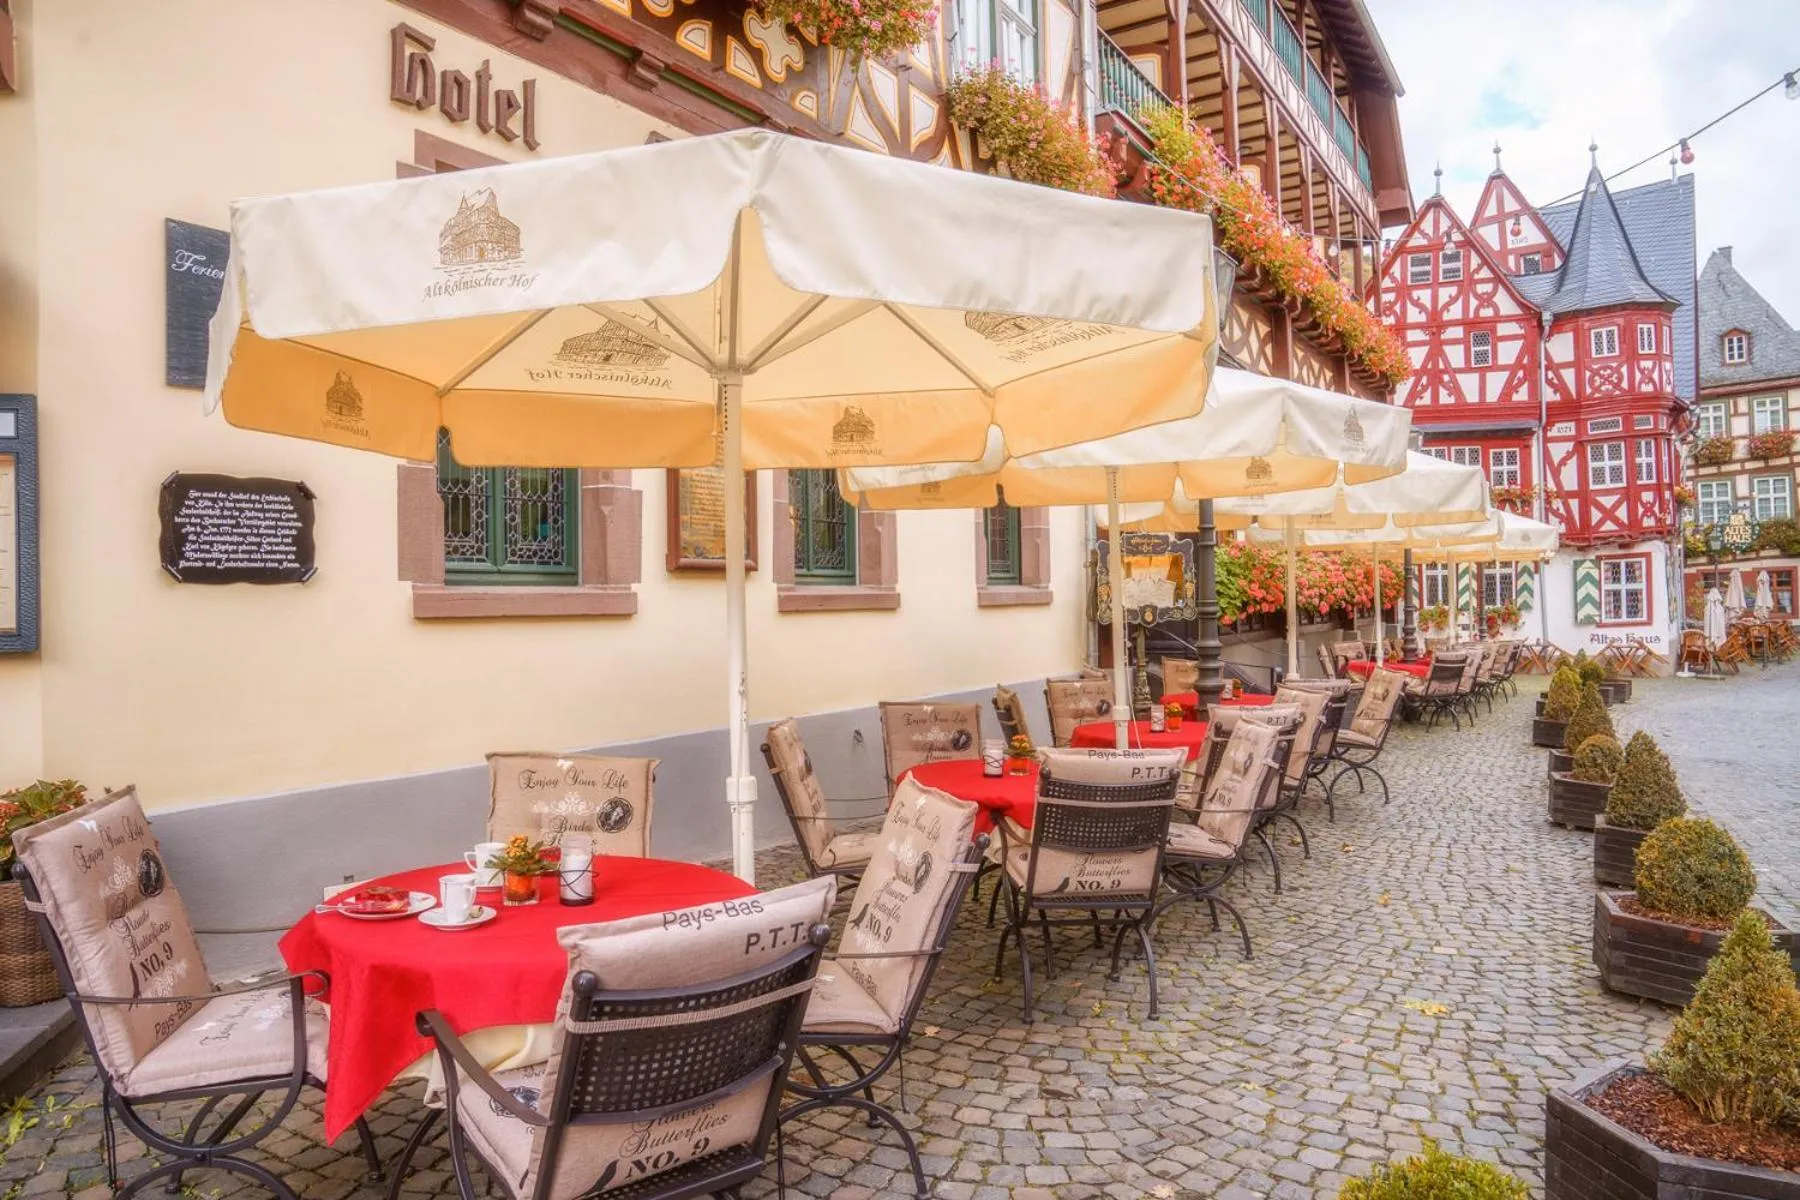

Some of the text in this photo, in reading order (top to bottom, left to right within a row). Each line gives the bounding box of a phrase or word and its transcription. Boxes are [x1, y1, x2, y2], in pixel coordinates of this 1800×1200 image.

[390, 21, 541, 152] Hotel
[422, 272, 541, 303] Altkölnischer Hof
[519, 766, 630, 795] Enjoy Your Life
[549, 814, 595, 834] Birds
[1075, 879, 1121, 891] NO. 9
[662, 899, 765, 931] Pays-Bas
[139, 940, 175, 982] NO. 9
[619, 1113, 730, 1159] Butterflies
[625, 1136, 711, 1180] NO. 9
